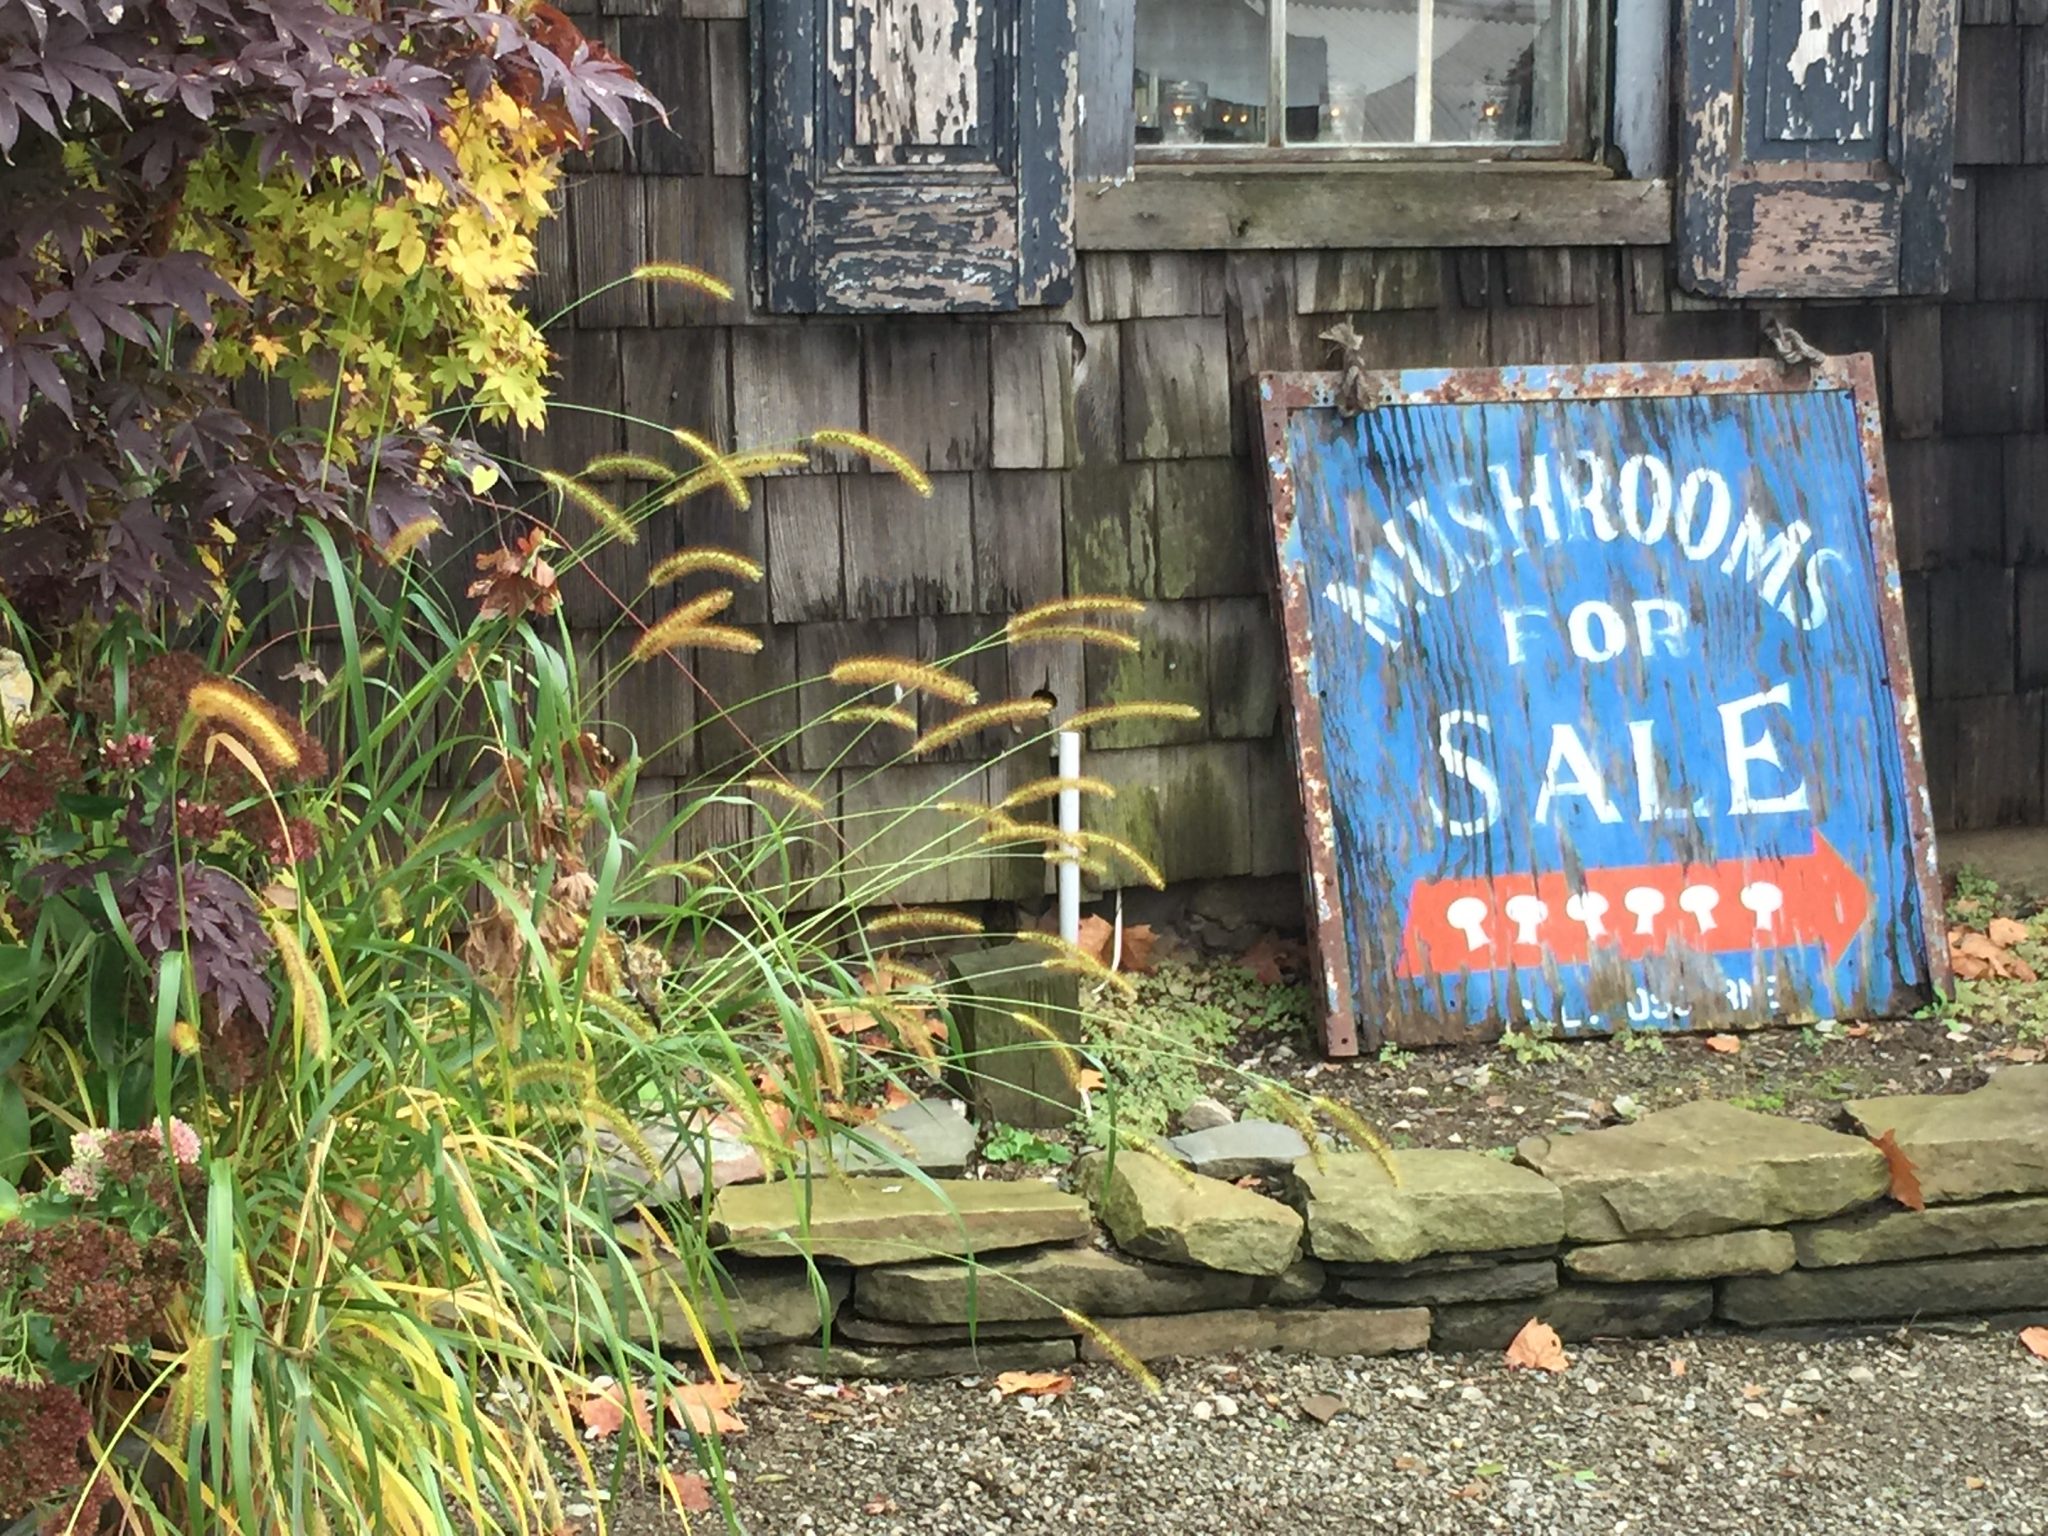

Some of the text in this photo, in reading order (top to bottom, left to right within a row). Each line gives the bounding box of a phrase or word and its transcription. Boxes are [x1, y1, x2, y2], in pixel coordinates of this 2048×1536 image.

[1322, 449, 1853, 653] MUSHROOMS
[1502, 598, 1692, 666] FOR
[1428, 681, 1811, 838] SALE
